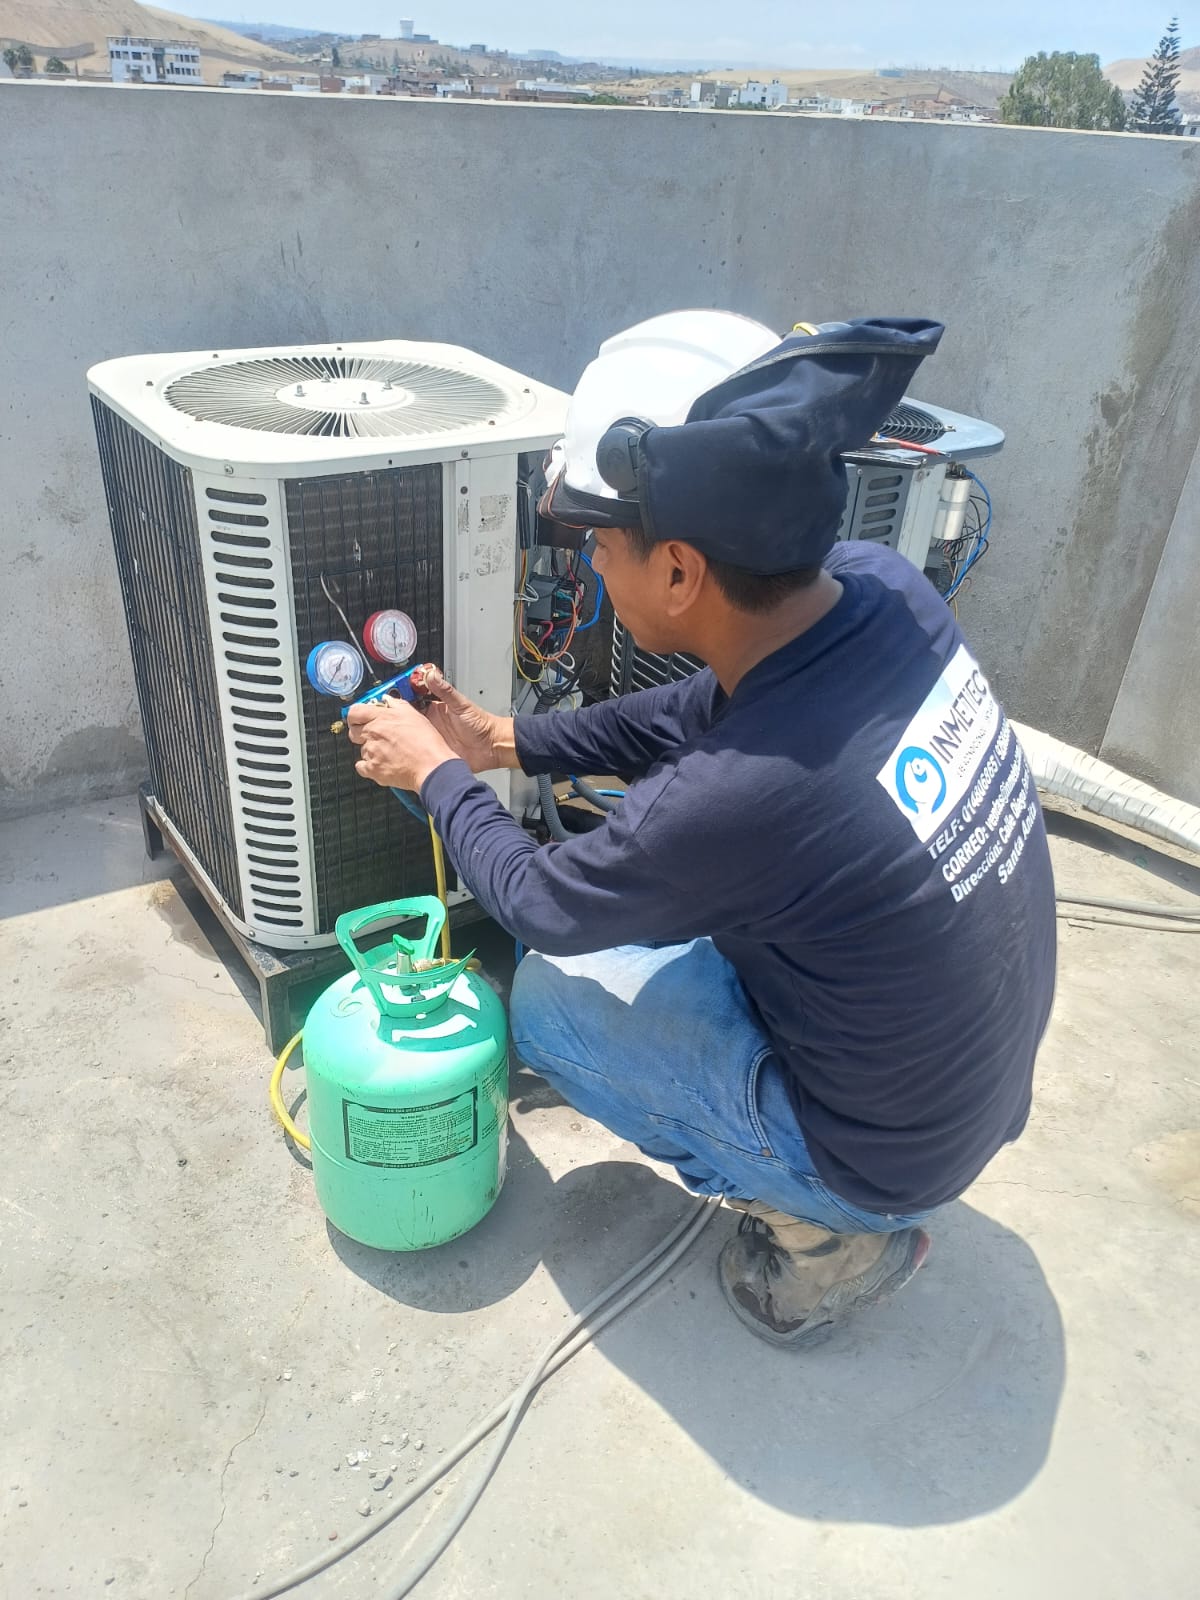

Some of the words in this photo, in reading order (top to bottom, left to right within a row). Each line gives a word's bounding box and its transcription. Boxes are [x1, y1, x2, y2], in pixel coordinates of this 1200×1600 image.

[929, 669, 987, 764] INMETEC
[926, 815, 965, 861] TELF:
[942, 826, 990, 882] CORREO:
[950, 842, 1003, 903] Dirección:
[998, 813, 1016, 845] Calle
[997, 835, 1024, 885] Santa
[1021, 801, 1037, 841] Anita
